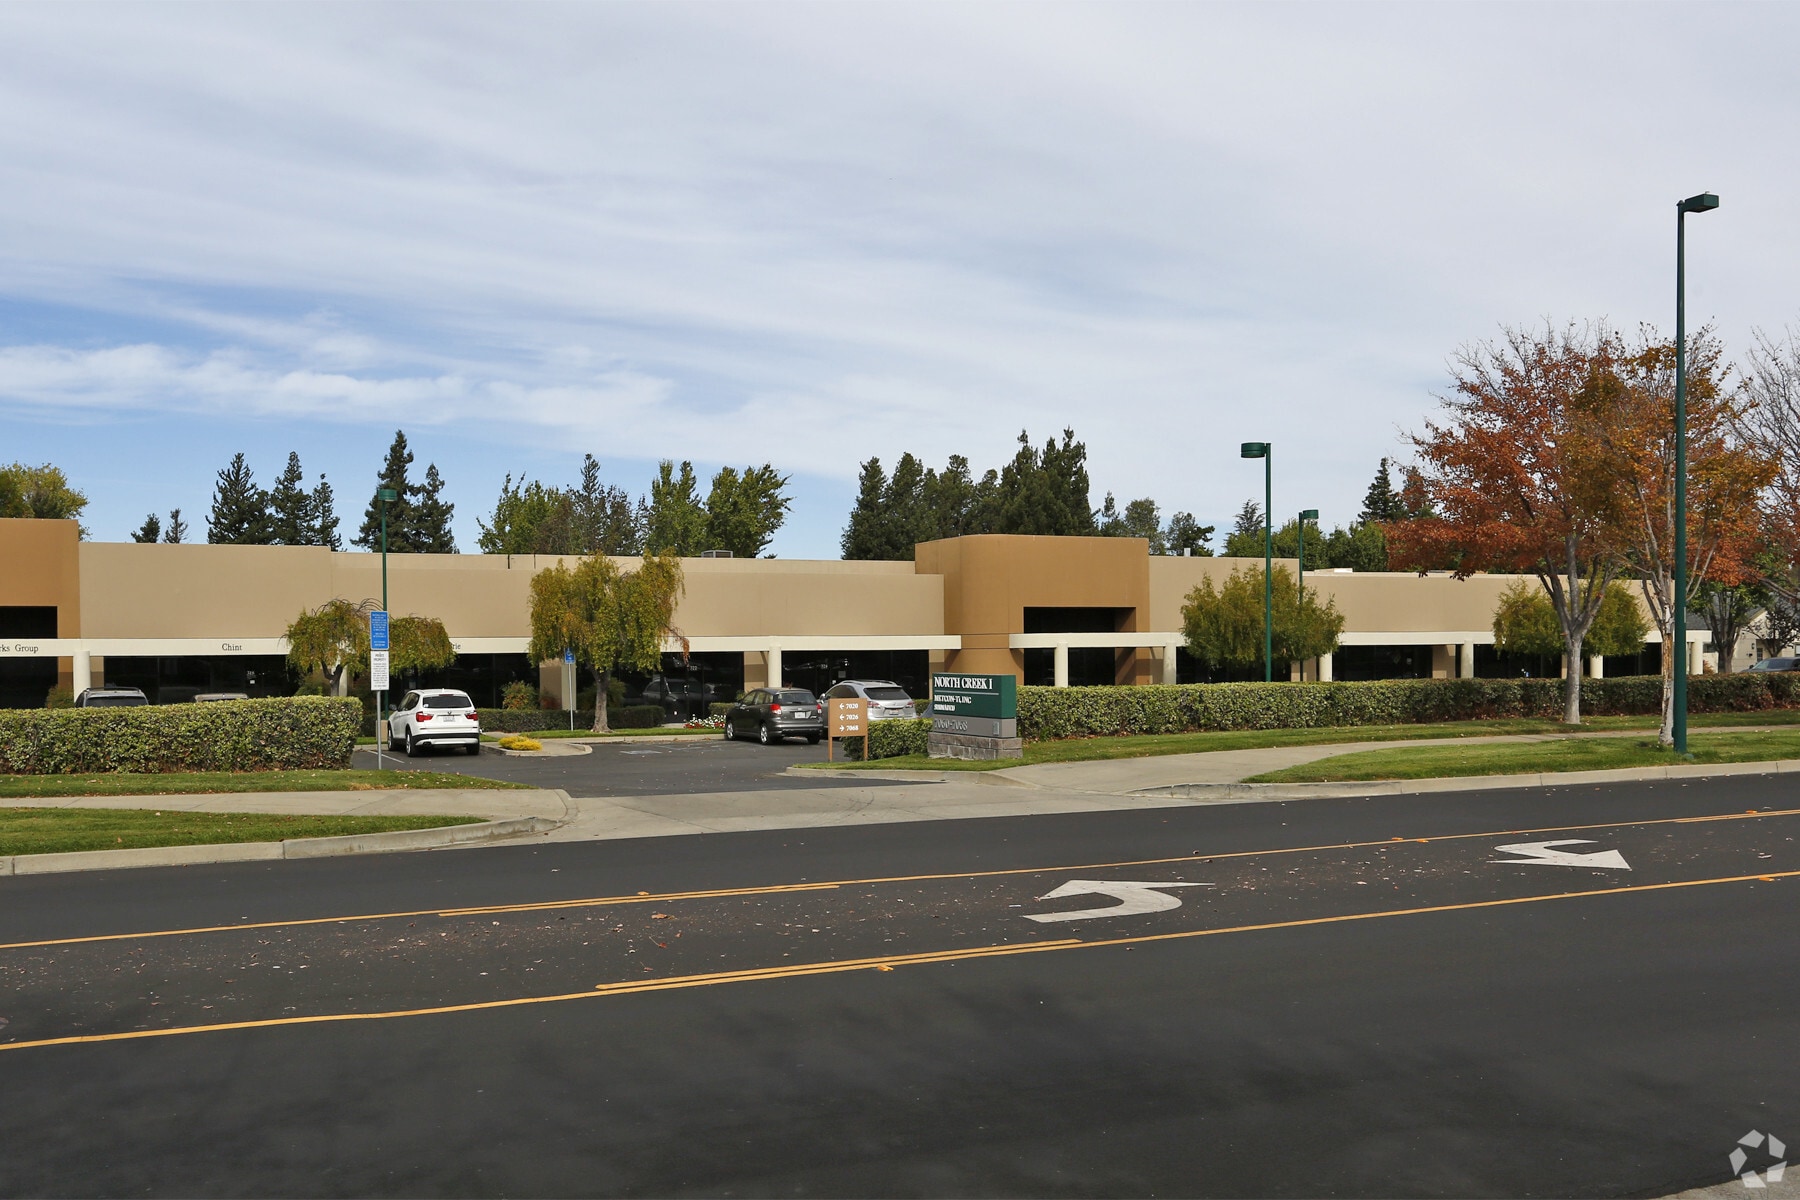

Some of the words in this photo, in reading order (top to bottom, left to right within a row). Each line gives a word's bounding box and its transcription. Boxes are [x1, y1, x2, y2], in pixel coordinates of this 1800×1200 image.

[15, 644, 39, 653] Group
[221, 643, 242, 651] Chint
[934, 676, 960, 688] NORTH
[961, 677, 988, 690] CREEK
